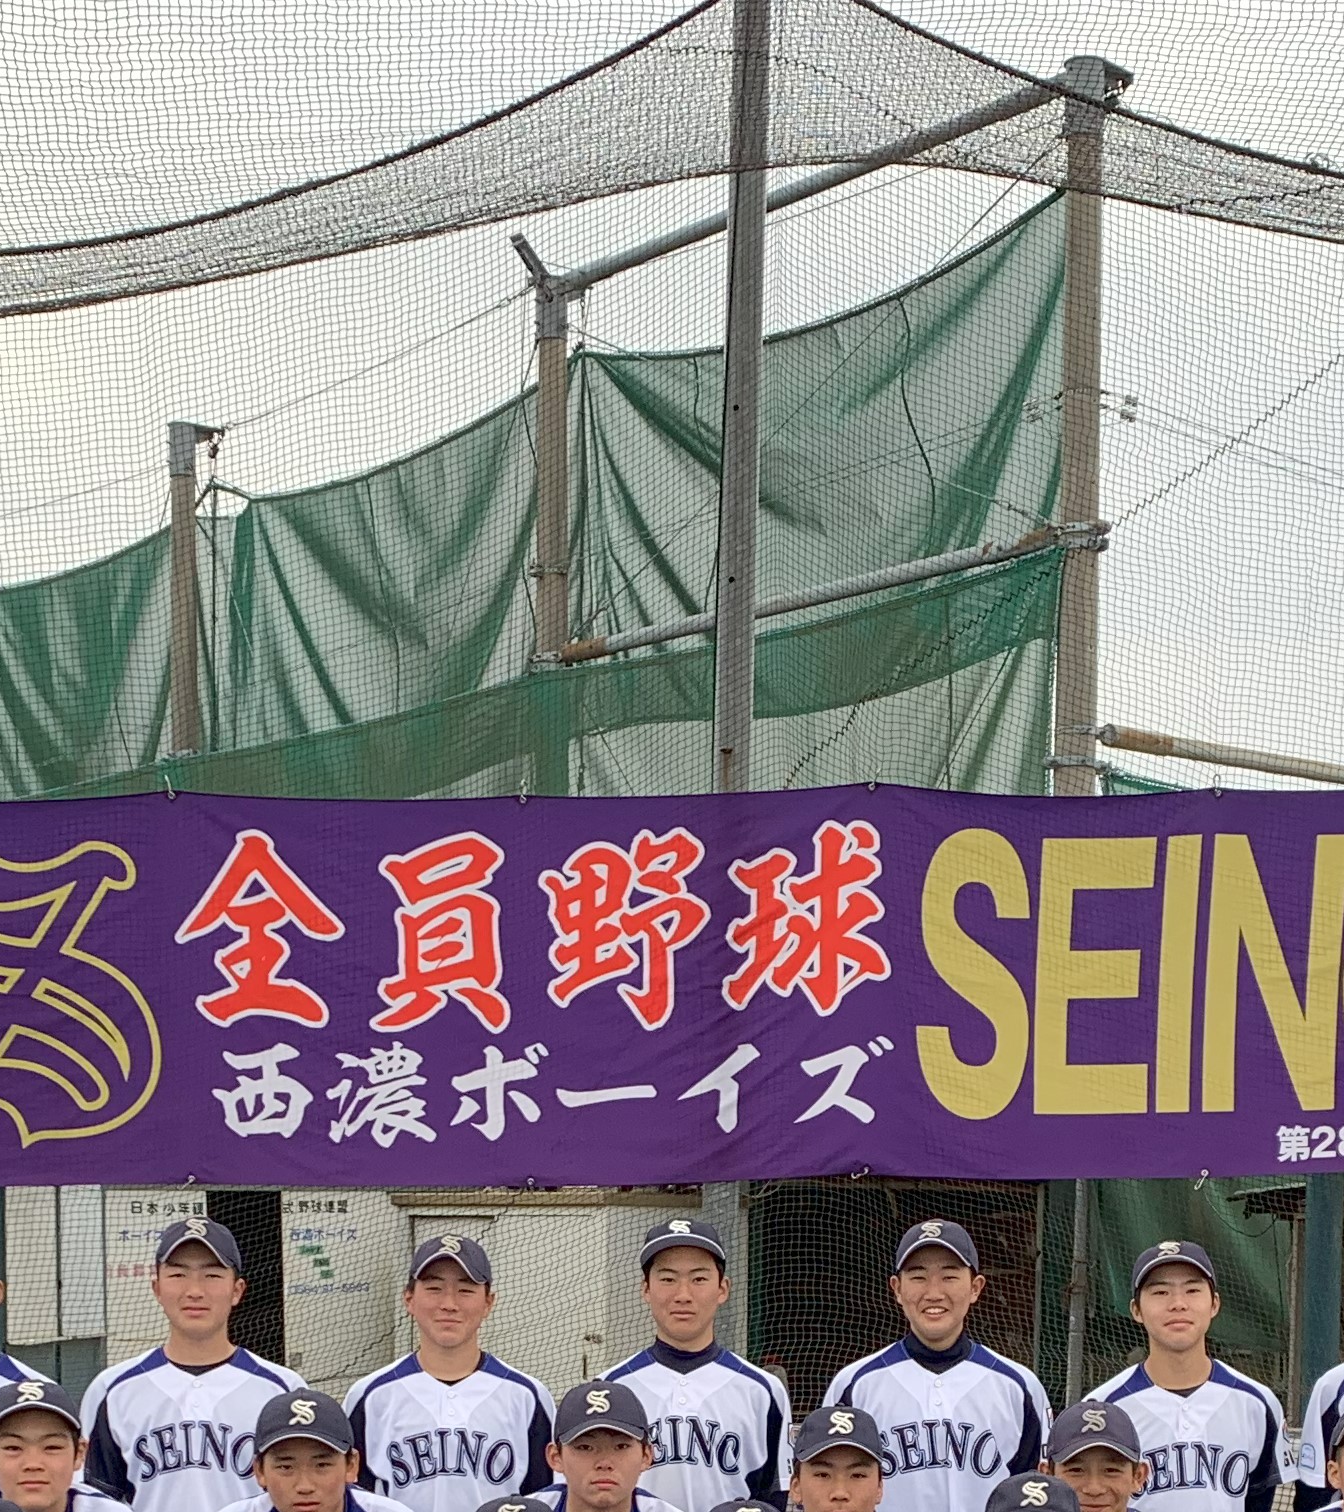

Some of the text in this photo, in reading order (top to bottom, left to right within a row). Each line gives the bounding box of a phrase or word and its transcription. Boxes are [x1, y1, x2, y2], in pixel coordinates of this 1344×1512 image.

[173, 819, 892, 1034] 全員野球
[212, 1034, 895, 1150] 西濃ボーイズ
[386, 1427, 515, 1490] SEINO
[1131, 1441, 1251, 1500] EINO
